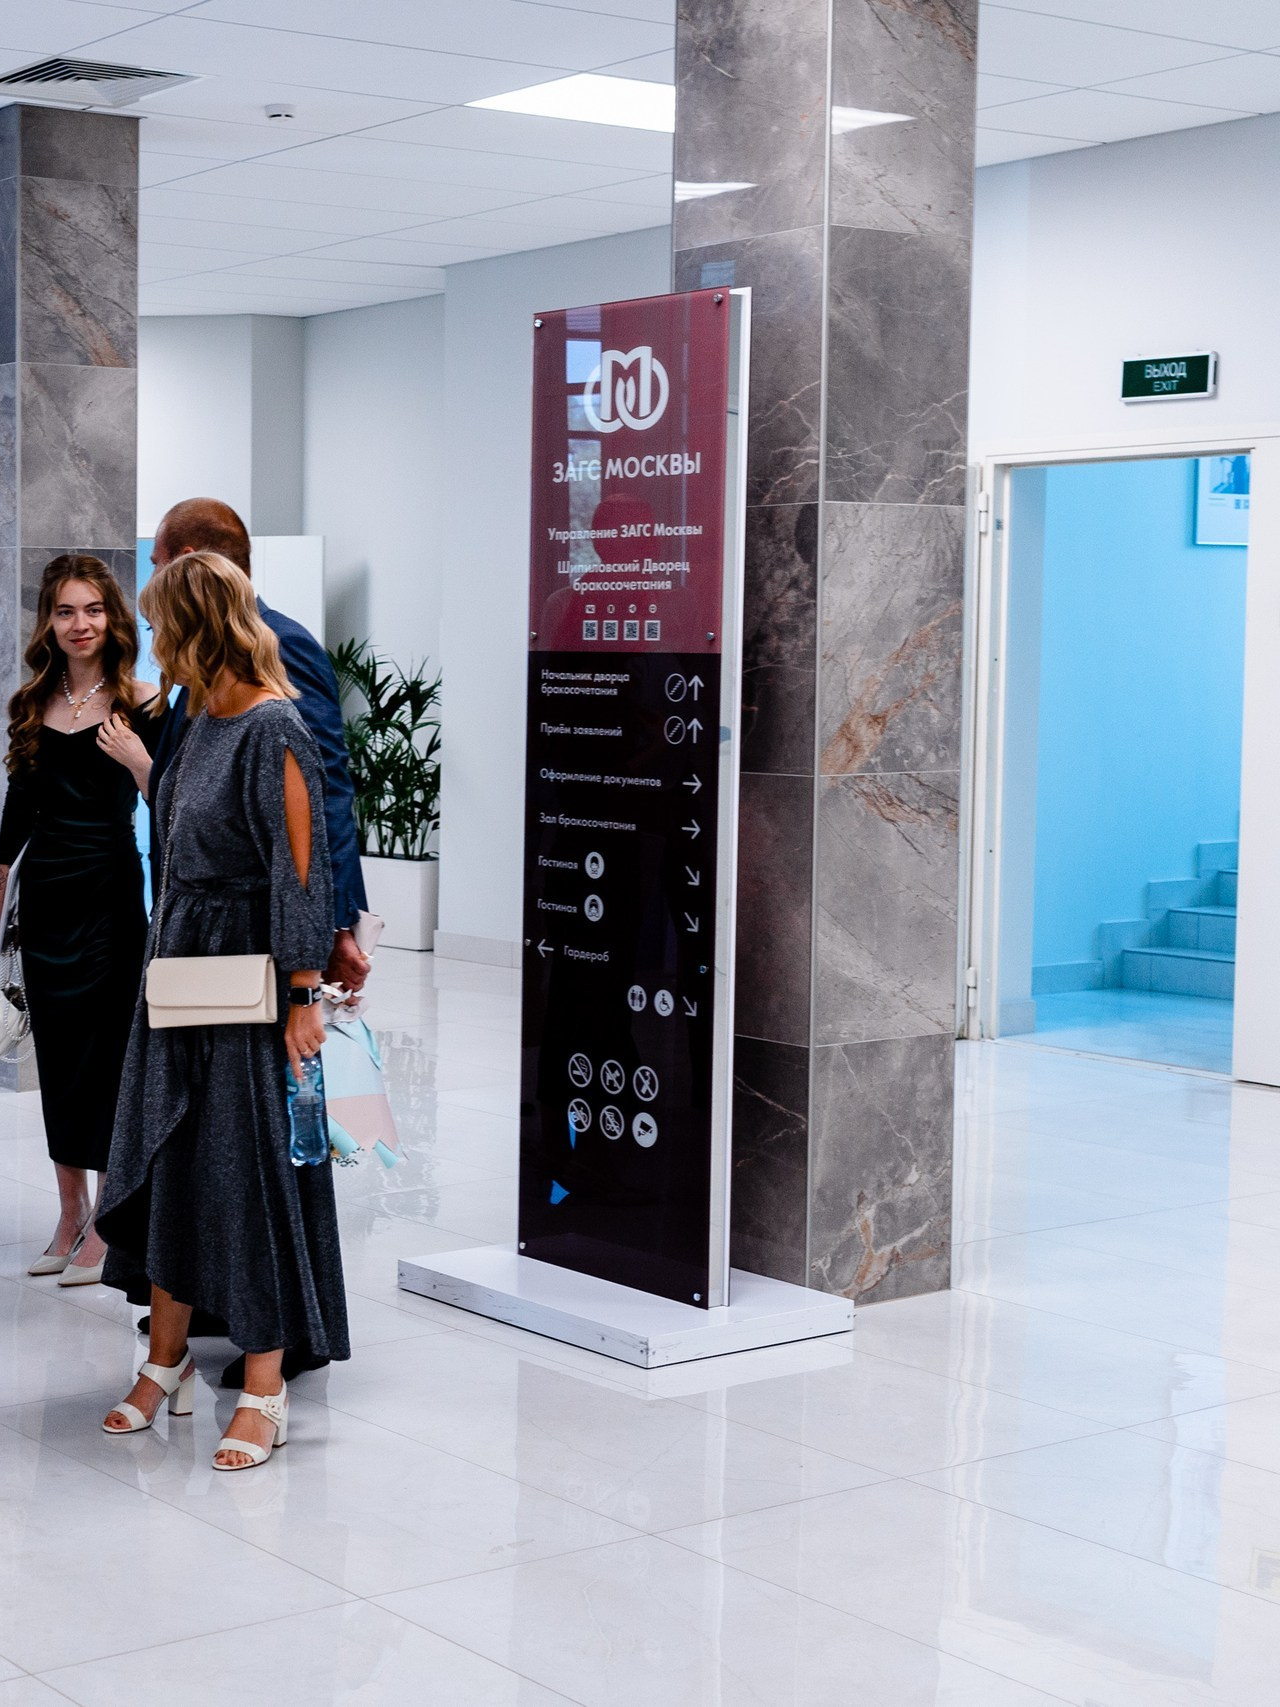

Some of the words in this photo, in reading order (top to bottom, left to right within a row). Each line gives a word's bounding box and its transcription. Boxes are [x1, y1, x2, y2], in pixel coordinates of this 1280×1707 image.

[1144, 361, 1188, 379] ВЫХОД
[1153, 379, 1180, 392] EXIT
[552, 459, 602, 483] ЗАГС
[604, 452, 701, 480] МОСКВЫ
[548, 528, 618, 543] Управление
[620, 524, 651, 538] ЗАГС
[653, 523, 703, 537] Москвы
[557, 560, 640, 574] Шипиловский
[642, 559, 690, 575] Дворец
[573, 577, 672, 595] бракосочетания
[541, 669, 592, 680] Начальник
[593, 673, 630, 684] дворца
[541, 682, 618, 696] бракосочетания
[540, 722, 571, 736] Приём
[573, 726, 623, 737] заявлений
[540, 768, 601, 783] Оформление
[603, 775, 662, 787] документов
[540, 812, 557, 824] Зал
[558, 813, 637, 831] бракосочетания
[538, 855, 578, 870] Гостиная
[537, 898, 577, 913] Гостиная
[564, 945, 610, 963] Гардероб
